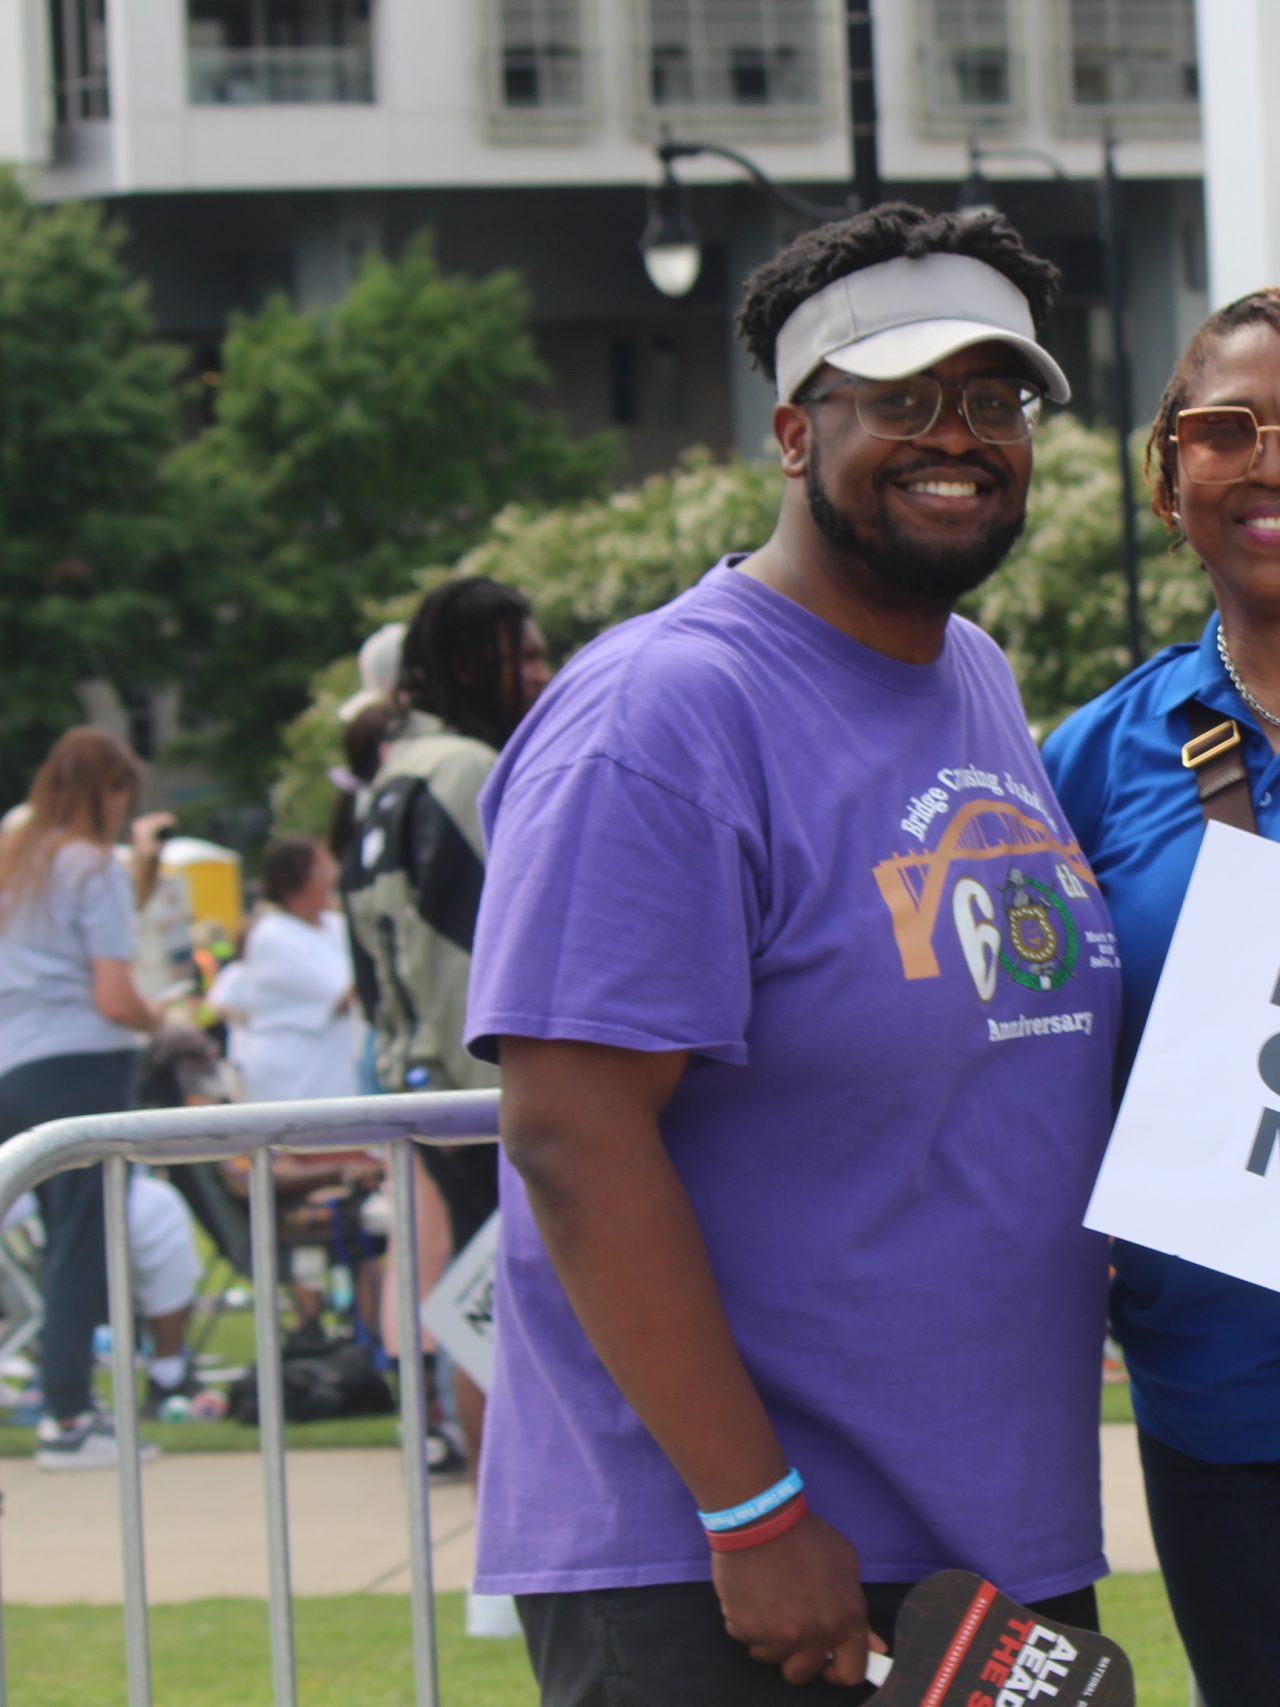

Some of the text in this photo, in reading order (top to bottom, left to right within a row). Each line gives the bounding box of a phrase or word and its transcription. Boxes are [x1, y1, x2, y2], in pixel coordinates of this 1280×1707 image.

[901, 785, 949, 842] Bridge
[987, 1011, 1094, 1042] Anniversary
[980, 1618, 1036, 1690] THE
[1027, 1634, 1078, 1700] ALL
[1081, 1656, 1111, 1696] NATIONAL
